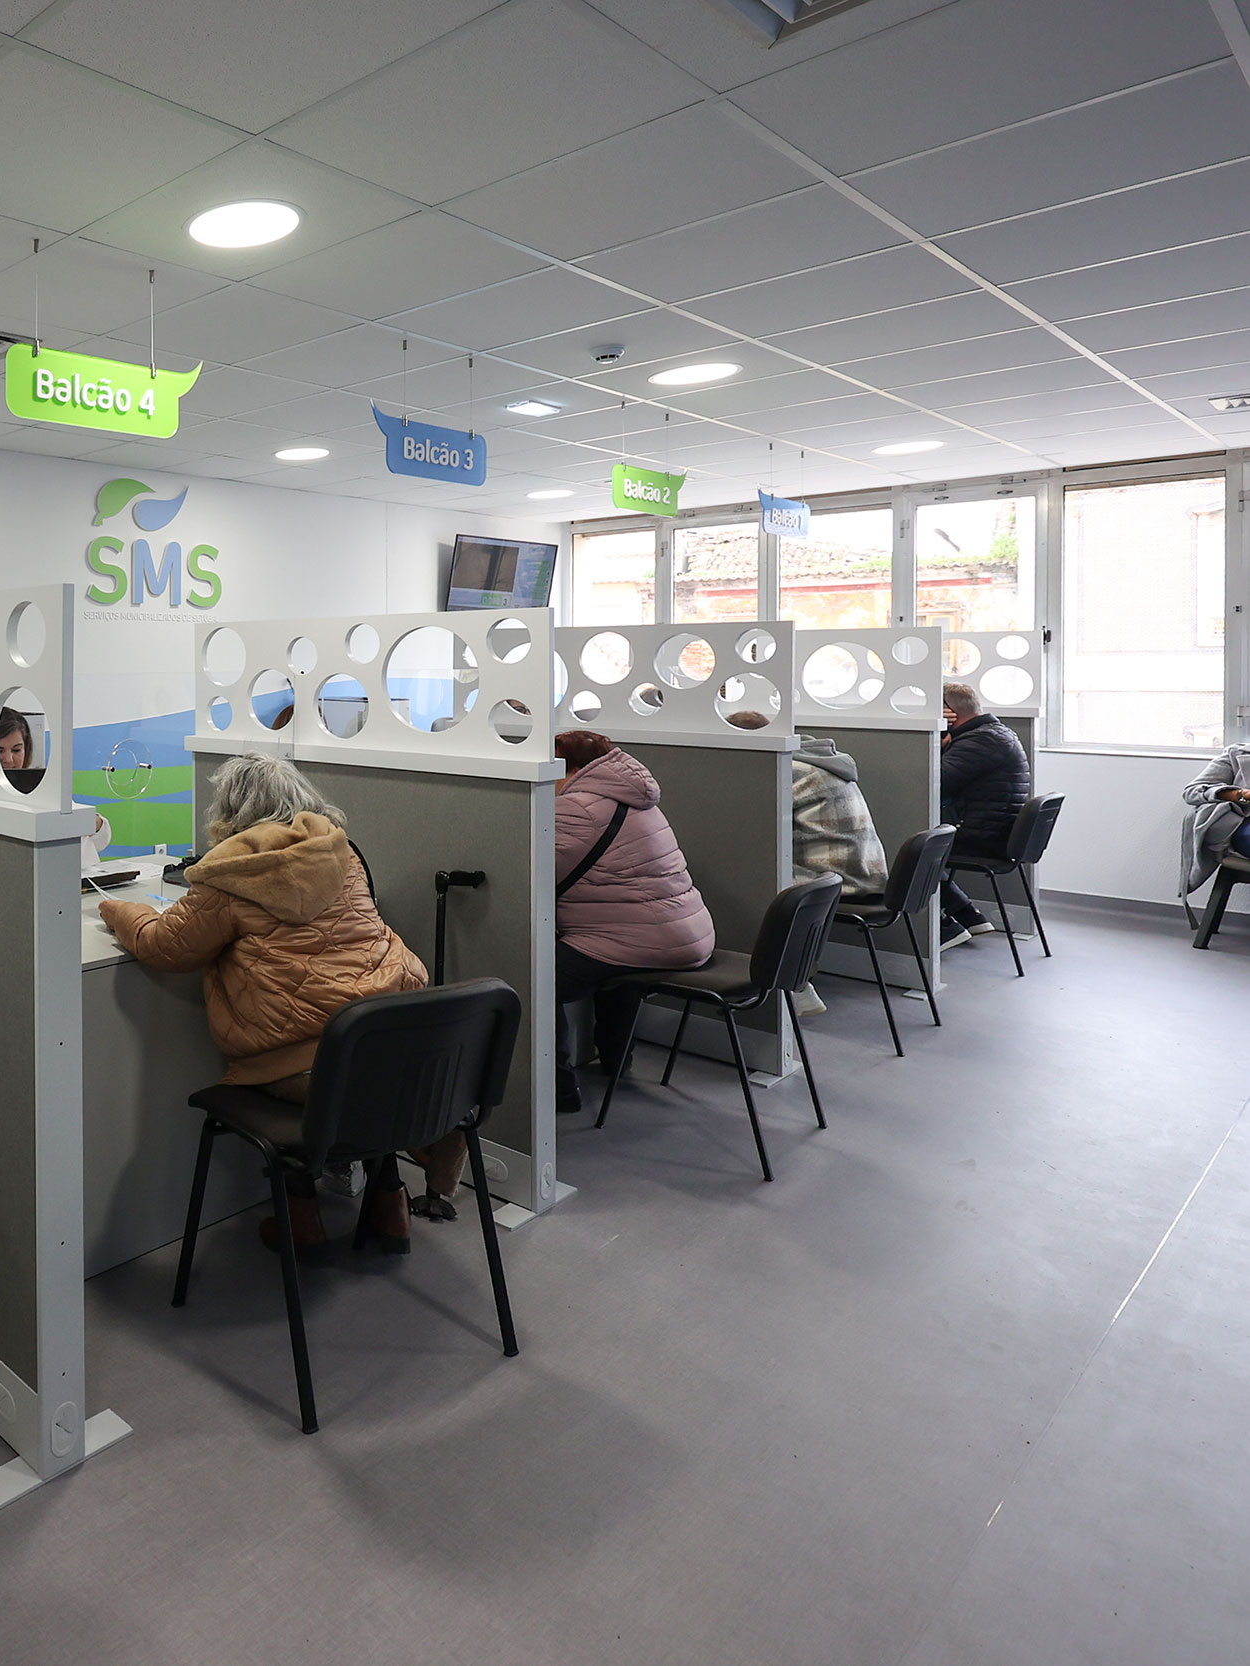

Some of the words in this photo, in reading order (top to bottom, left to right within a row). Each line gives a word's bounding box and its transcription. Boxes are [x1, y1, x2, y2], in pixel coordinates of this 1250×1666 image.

[36, 368, 132, 412] Balcão
[139, 389, 156, 416] 4
[403, 437, 460, 468] Balcão
[463, 449, 474, 470] 3
[623, 478, 661, 503] Balcão
[662, 487, 671, 504] 2
[772, 508, 797, 527] Balcão
[85, 536, 222, 610] SMS
